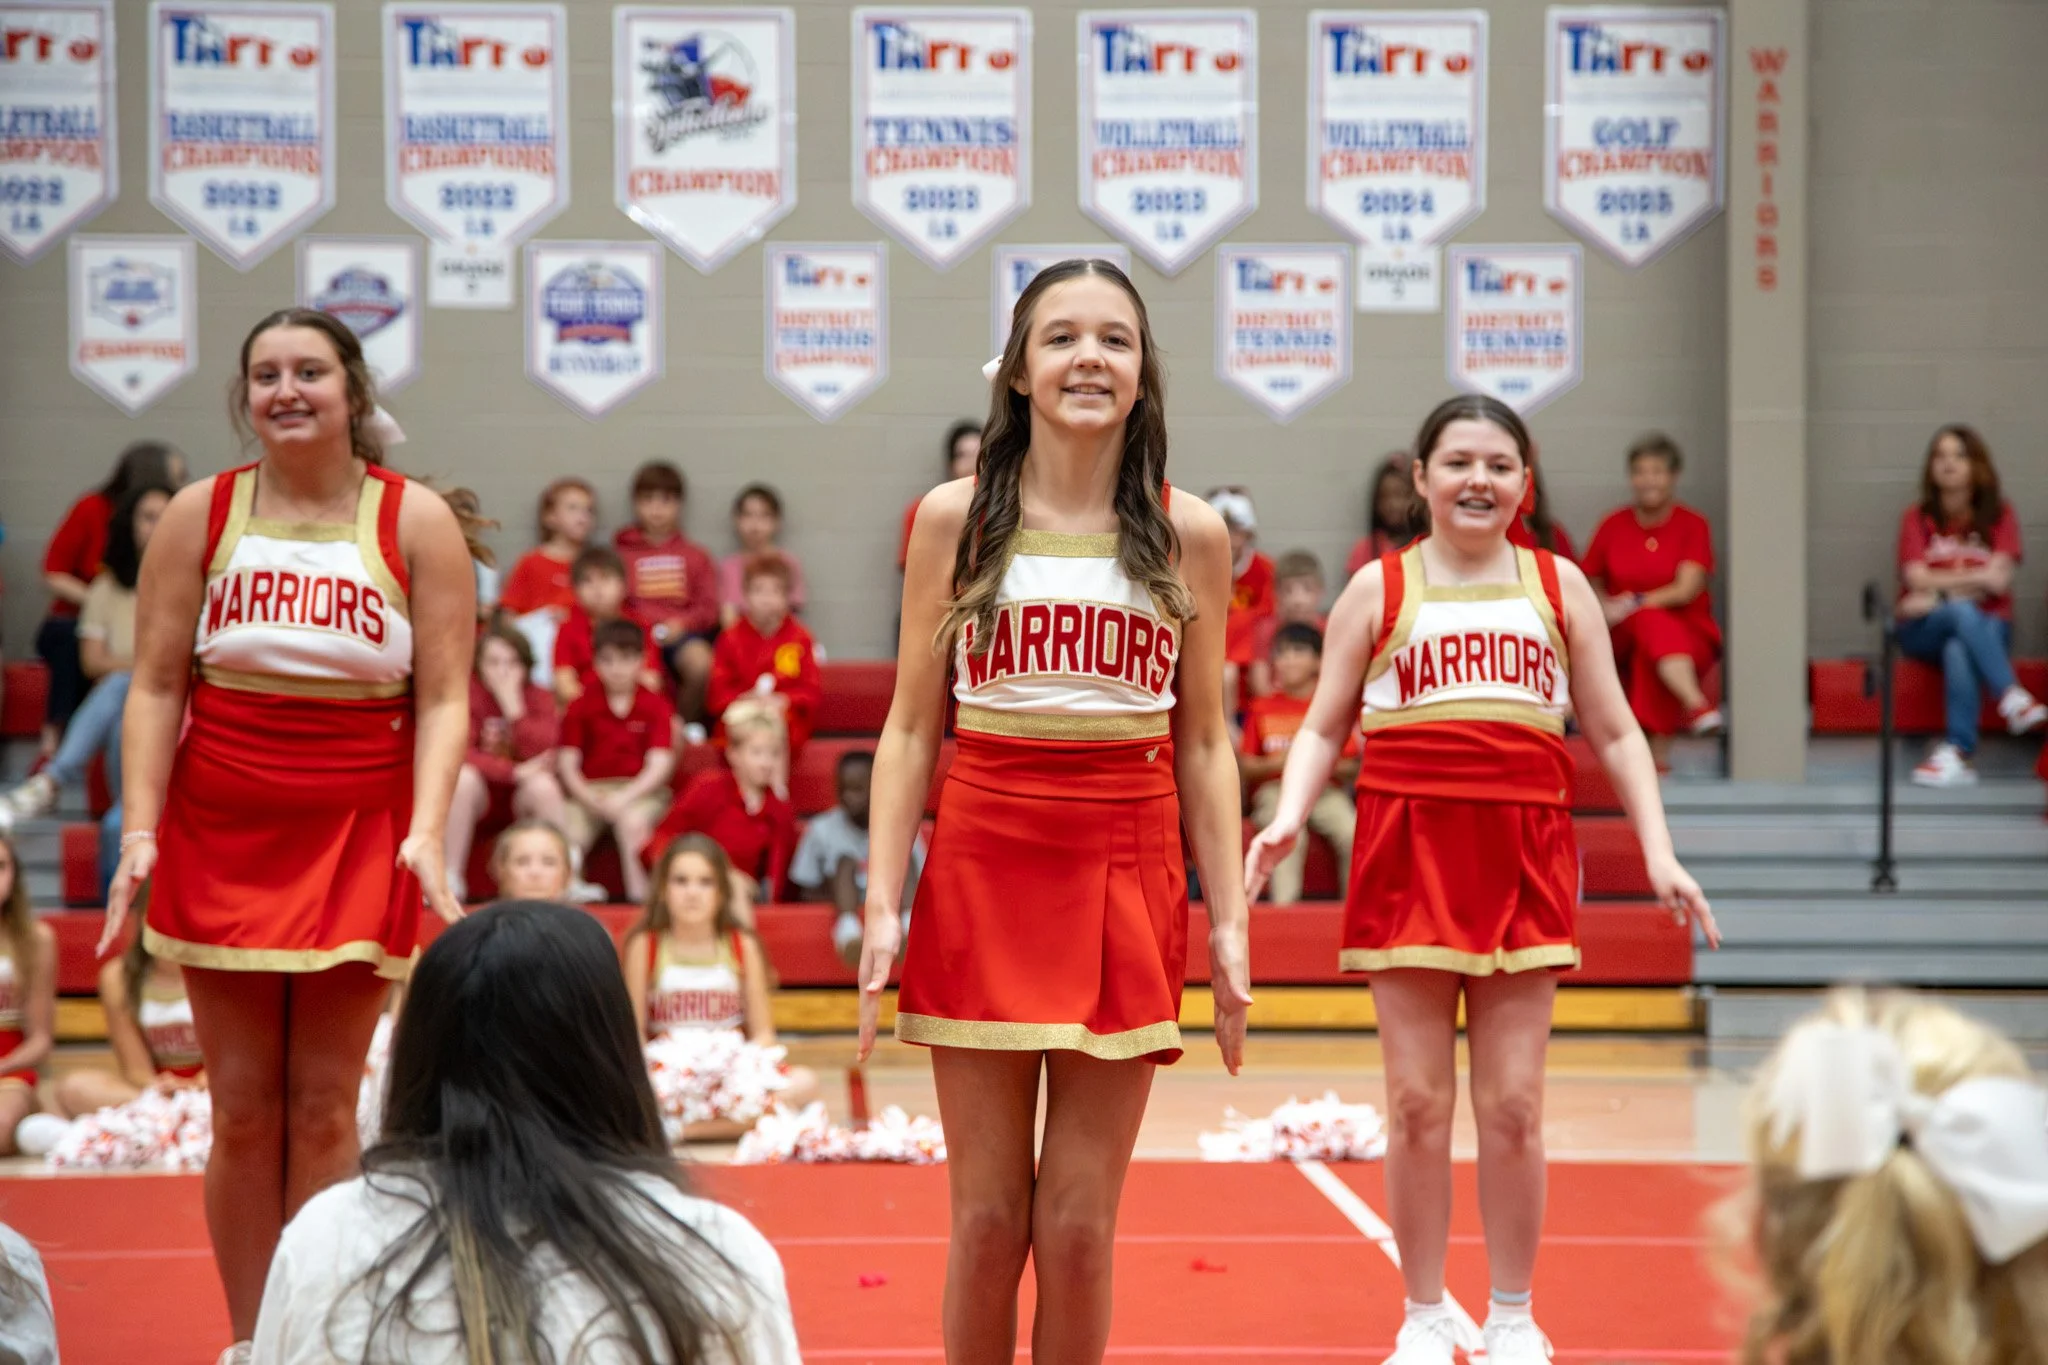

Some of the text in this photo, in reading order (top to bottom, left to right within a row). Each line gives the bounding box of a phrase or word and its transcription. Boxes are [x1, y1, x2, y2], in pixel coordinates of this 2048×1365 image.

[868, 116, 1017, 148] TENNIS
[1095, 118, 1245, 150] VOLLEYBALL
[1325, 119, 1472, 151] VOLLEYBALL
[1592, 116, 1681, 147] GOLF
[865, 147, 1016, 178] CHAMPION
[1092, 149, 1245, 181] CHAMPION
[1321, 150, 1471, 182] CHAMPION
[1558, 149, 1712, 181] CHAMPION
[1749, 47, 1789, 291] WARRIORS
[628, 169, 783, 200] CHAMPION
[205, 570, 386, 646] WARRIORS
[964, 602, 1175, 698] WARRIORS
[1393, 631, 1558, 705] WARRIORS
